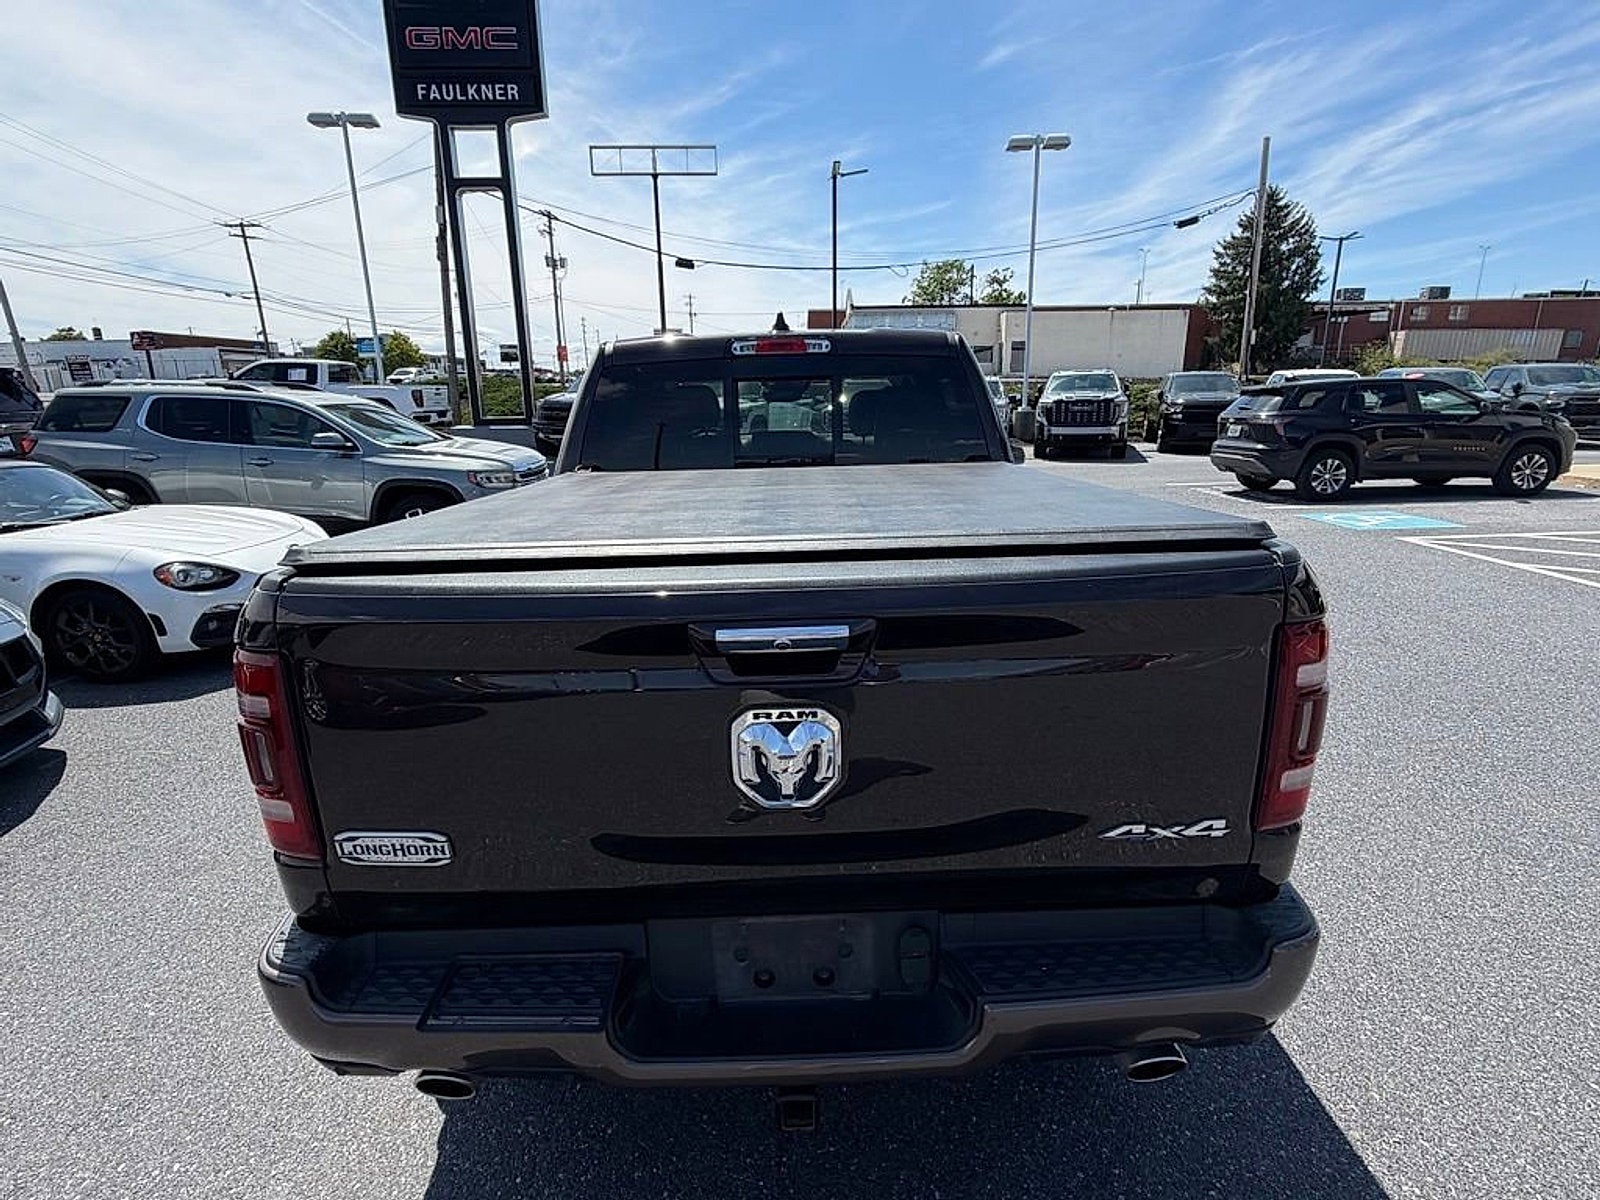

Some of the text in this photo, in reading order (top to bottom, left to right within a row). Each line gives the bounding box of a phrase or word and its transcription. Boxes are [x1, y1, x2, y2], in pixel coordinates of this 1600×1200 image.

[405, 26, 519, 50] GMC
[416, 84, 519, 101] FAULKNER
[752, 710, 818, 720] RAM
[339, 842, 447, 858] LONGHORN
